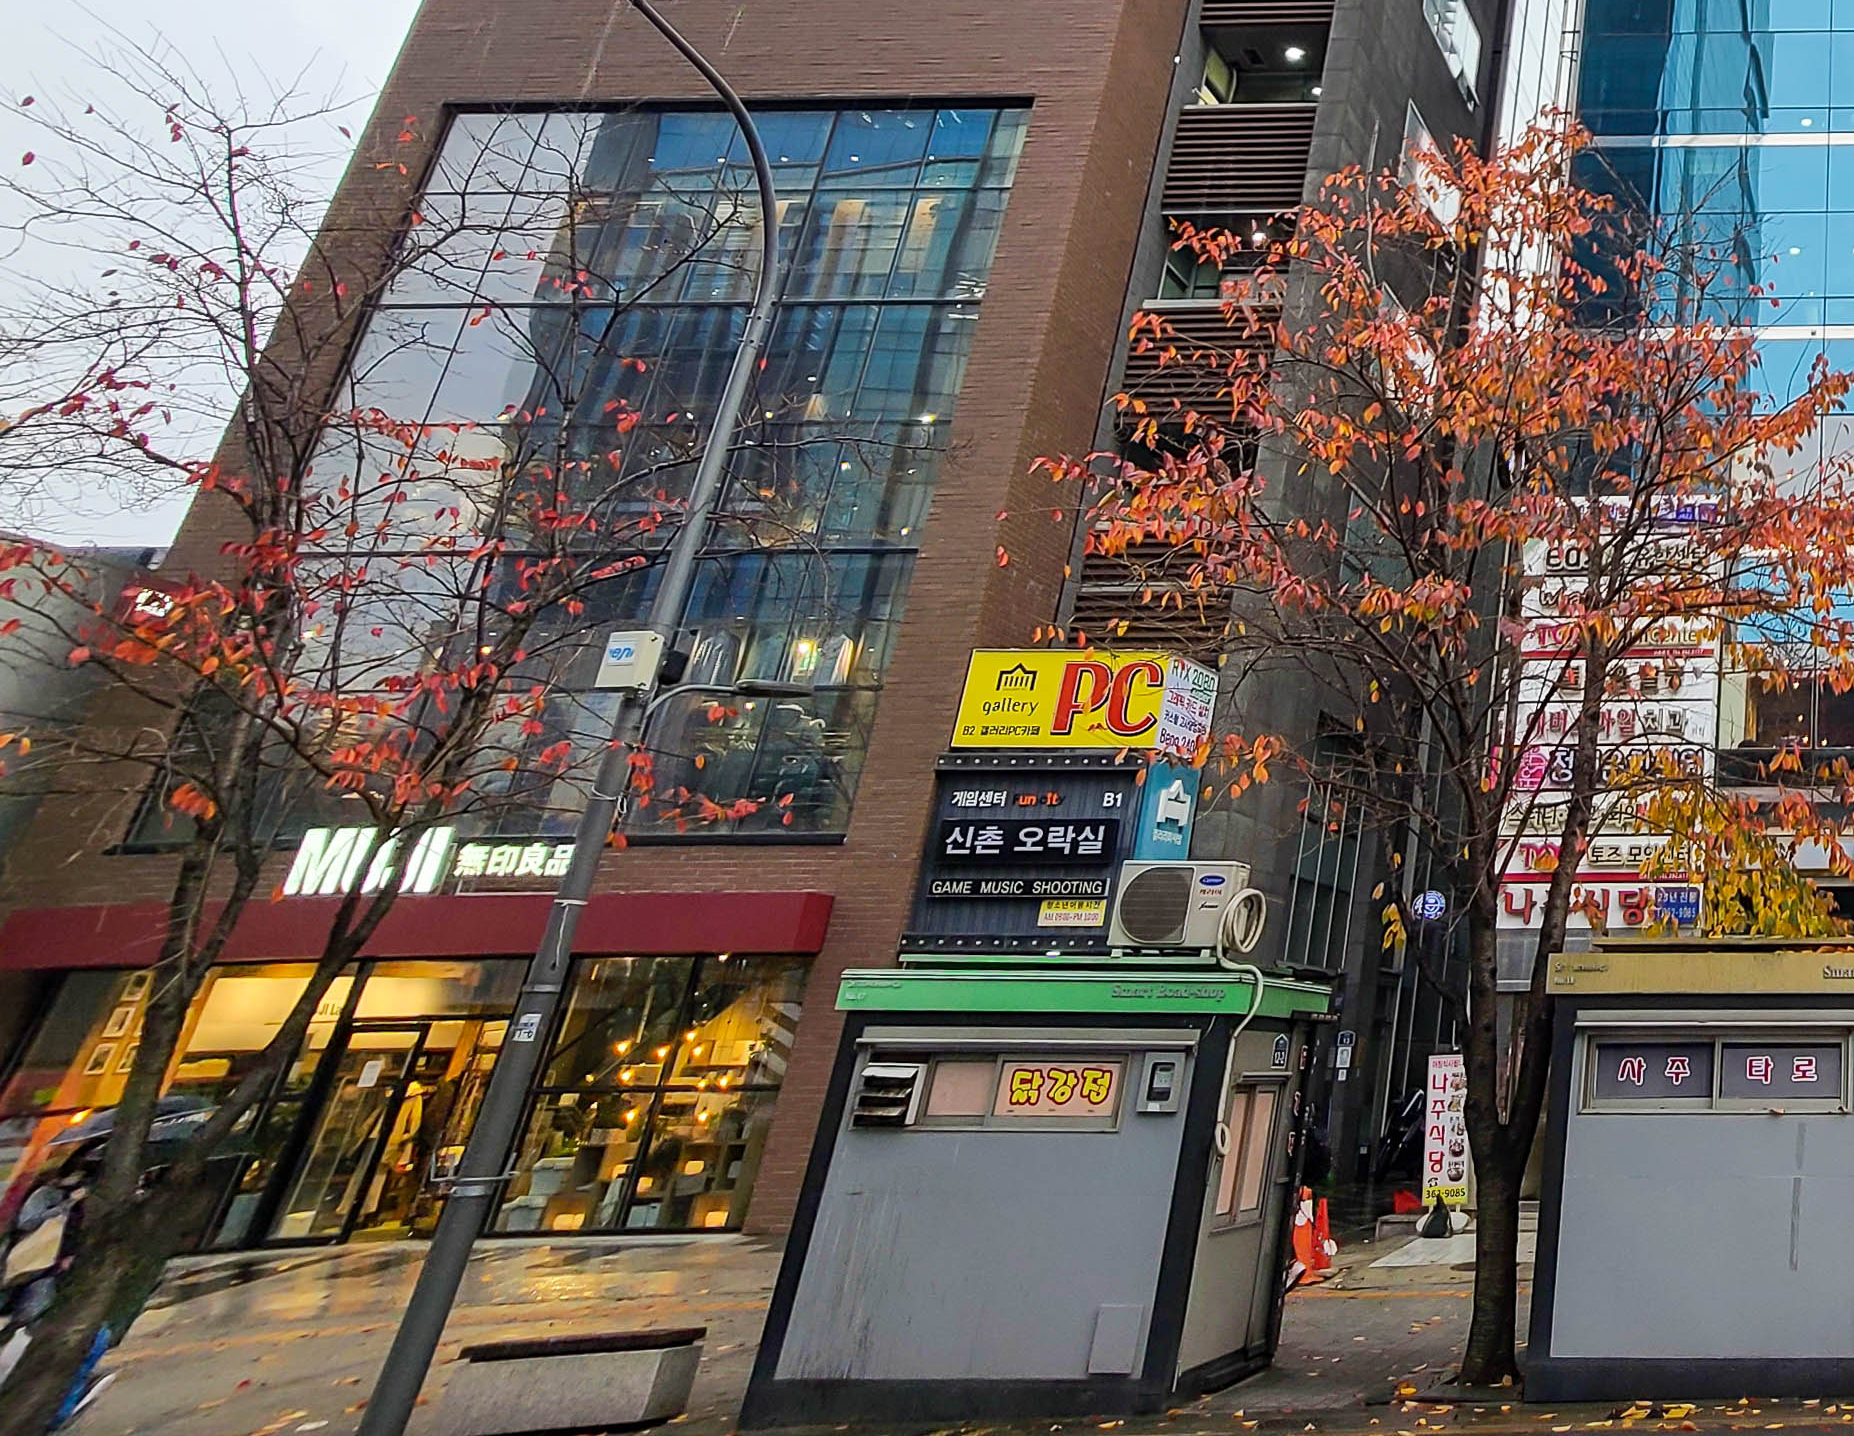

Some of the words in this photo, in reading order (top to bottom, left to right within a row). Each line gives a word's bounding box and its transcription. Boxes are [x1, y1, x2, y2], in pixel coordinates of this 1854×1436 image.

[982, 698, 1039, 716] gallery
[1050, 660, 1164, 737] PC
[962, 725, 976, 736] B2
[951, 790, 1008, 808] 게임센터
[1102, 793, 1123, 808] B1
[945, 825, 1005, 855] 신촌
[1013, 825, 1106, 855] 오락실
[453, 842, 577, 877] 無印良品
[931, 881, 973, 894] GAME
[980, 881, 1025, 894] MUSIC
[1032, 880, 1103, 895] SHOOTING
[1504, 888, 1650, 925] 나식당
[1112, 985, 1154, 998] Smart
[1155, 986, 1226, 1003] Road-shop
[1009, 1068, 1113, 1106] 닭강정
[1429, 1072, 1449, 1174] 나주식당
